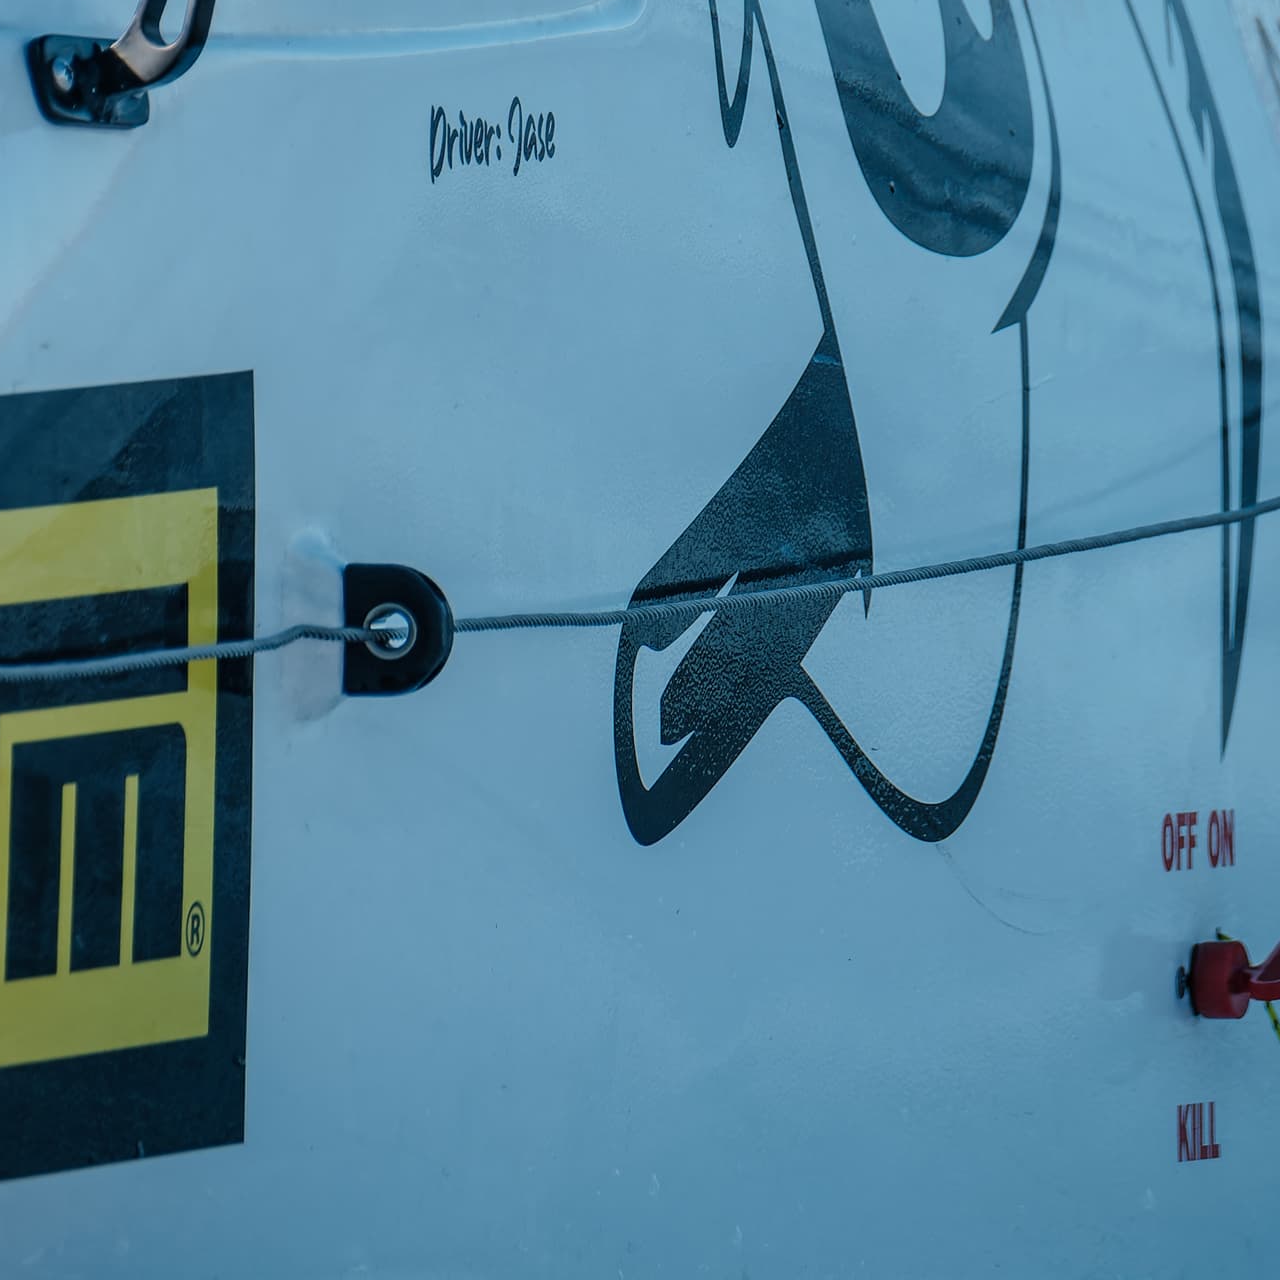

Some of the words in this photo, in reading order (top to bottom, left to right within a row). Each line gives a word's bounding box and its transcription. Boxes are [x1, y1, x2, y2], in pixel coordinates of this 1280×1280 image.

[429, 104, 502, 184] Driver:
[508, 96, 556, 176] Jase
[1161, 811, 1198, 872] OFF
[1207, 809, 1235, 868] ON
[1177, 1101, 1221, 1162] KILL
